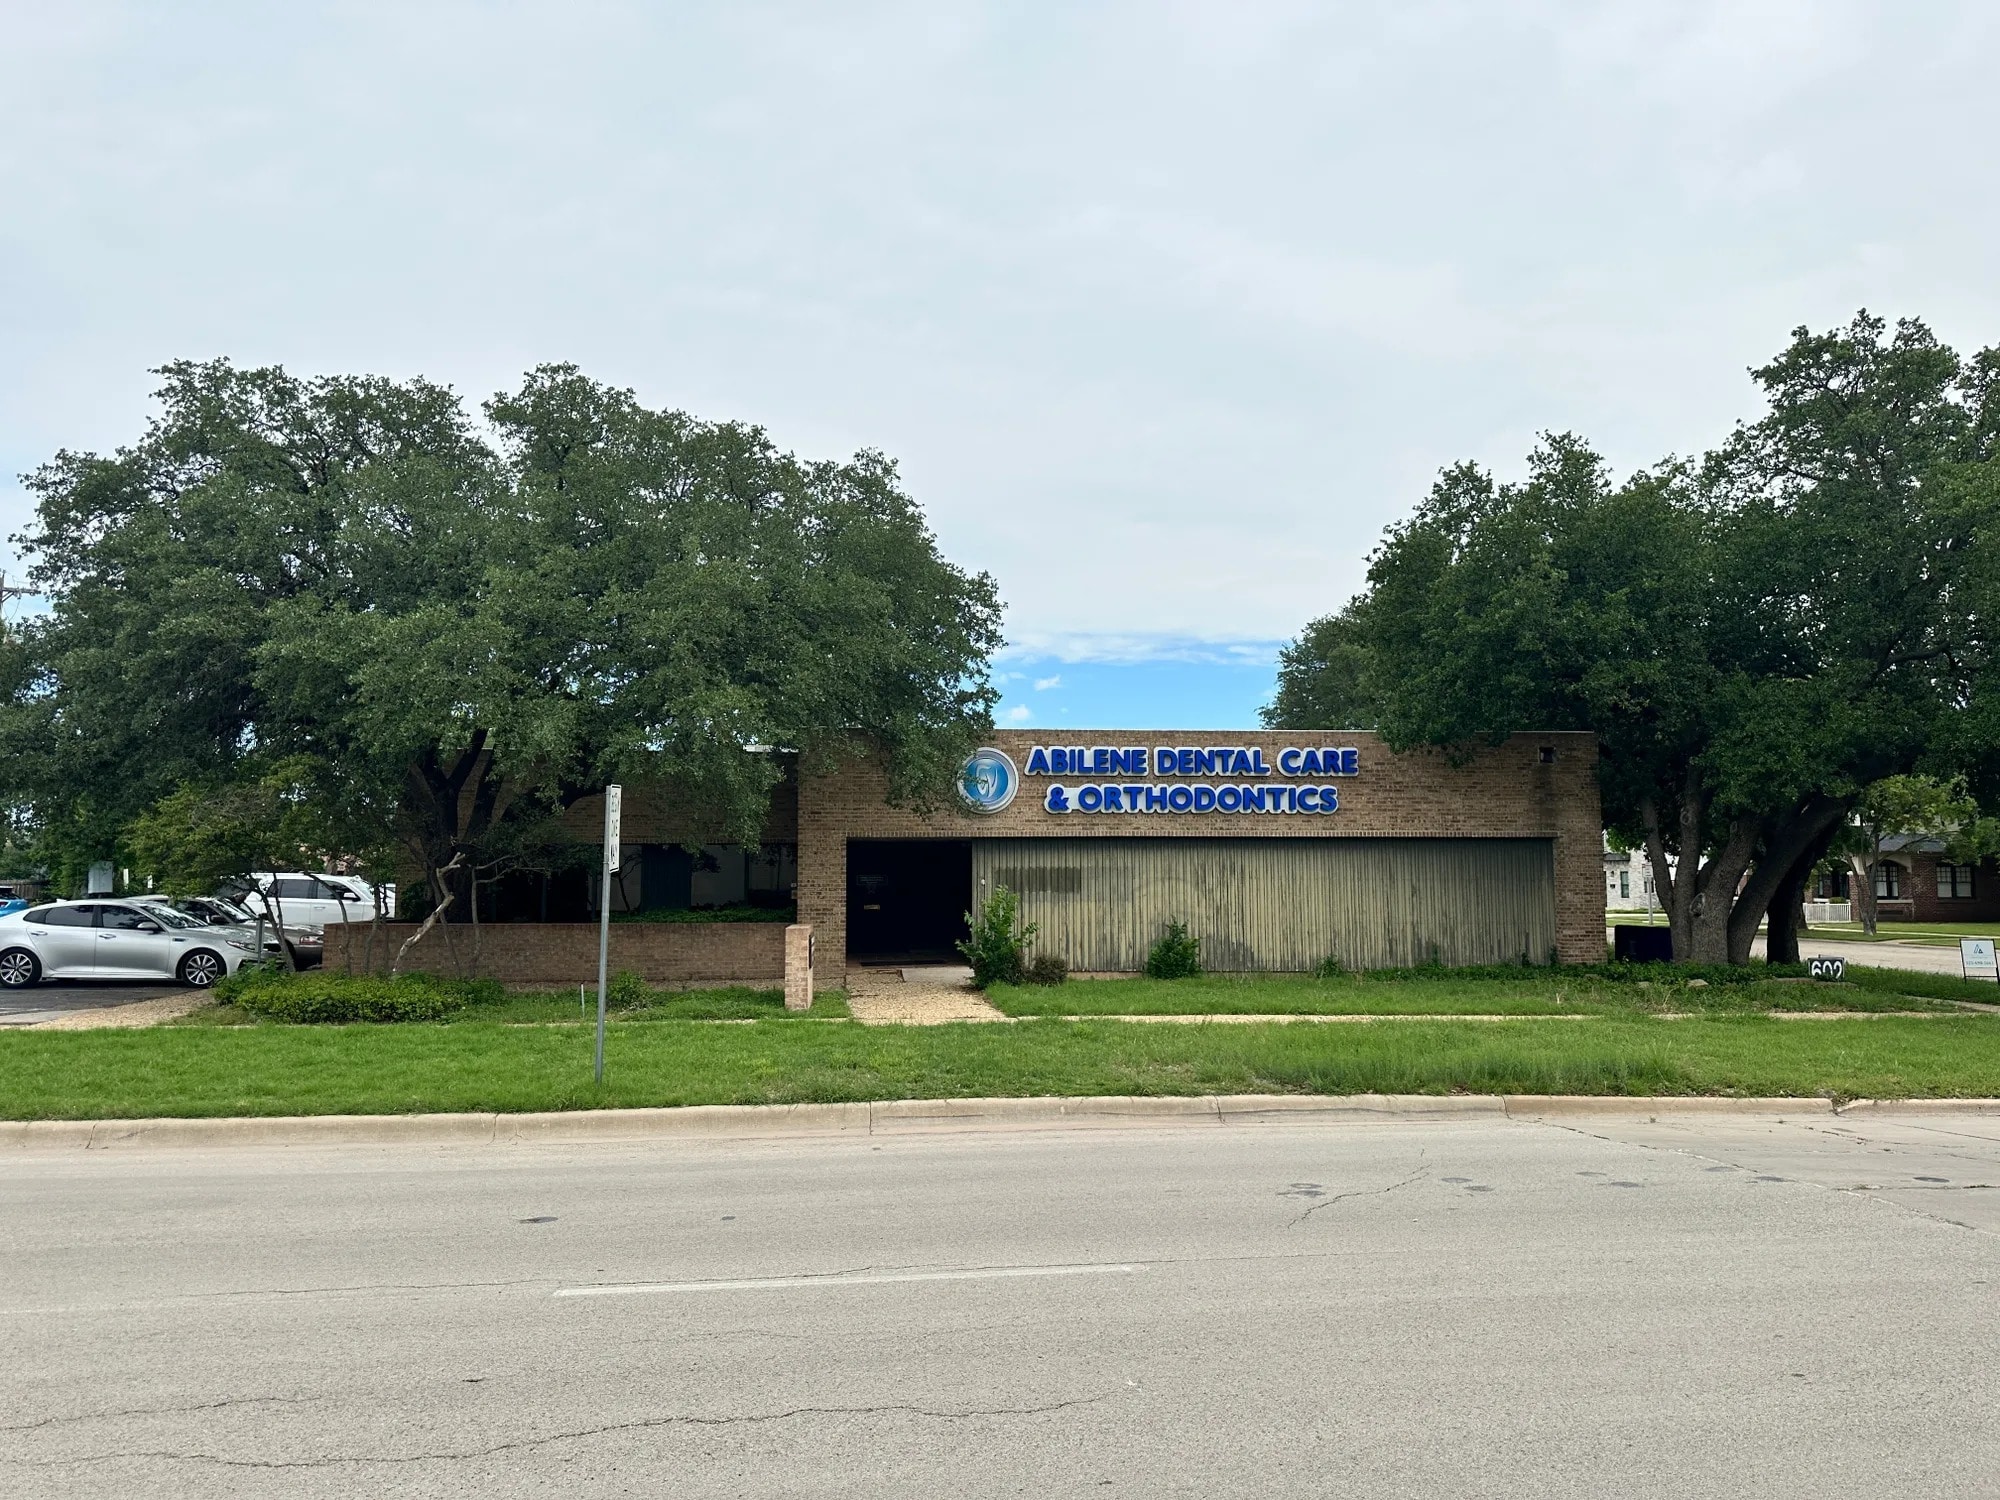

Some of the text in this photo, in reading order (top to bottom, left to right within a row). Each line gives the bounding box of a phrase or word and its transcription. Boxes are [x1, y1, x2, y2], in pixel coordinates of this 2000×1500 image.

[1027, 747, 1359, 774] ABILENE DENTAL CARE
[1047, 785, 1338, 812] & ORTHODONTICS
